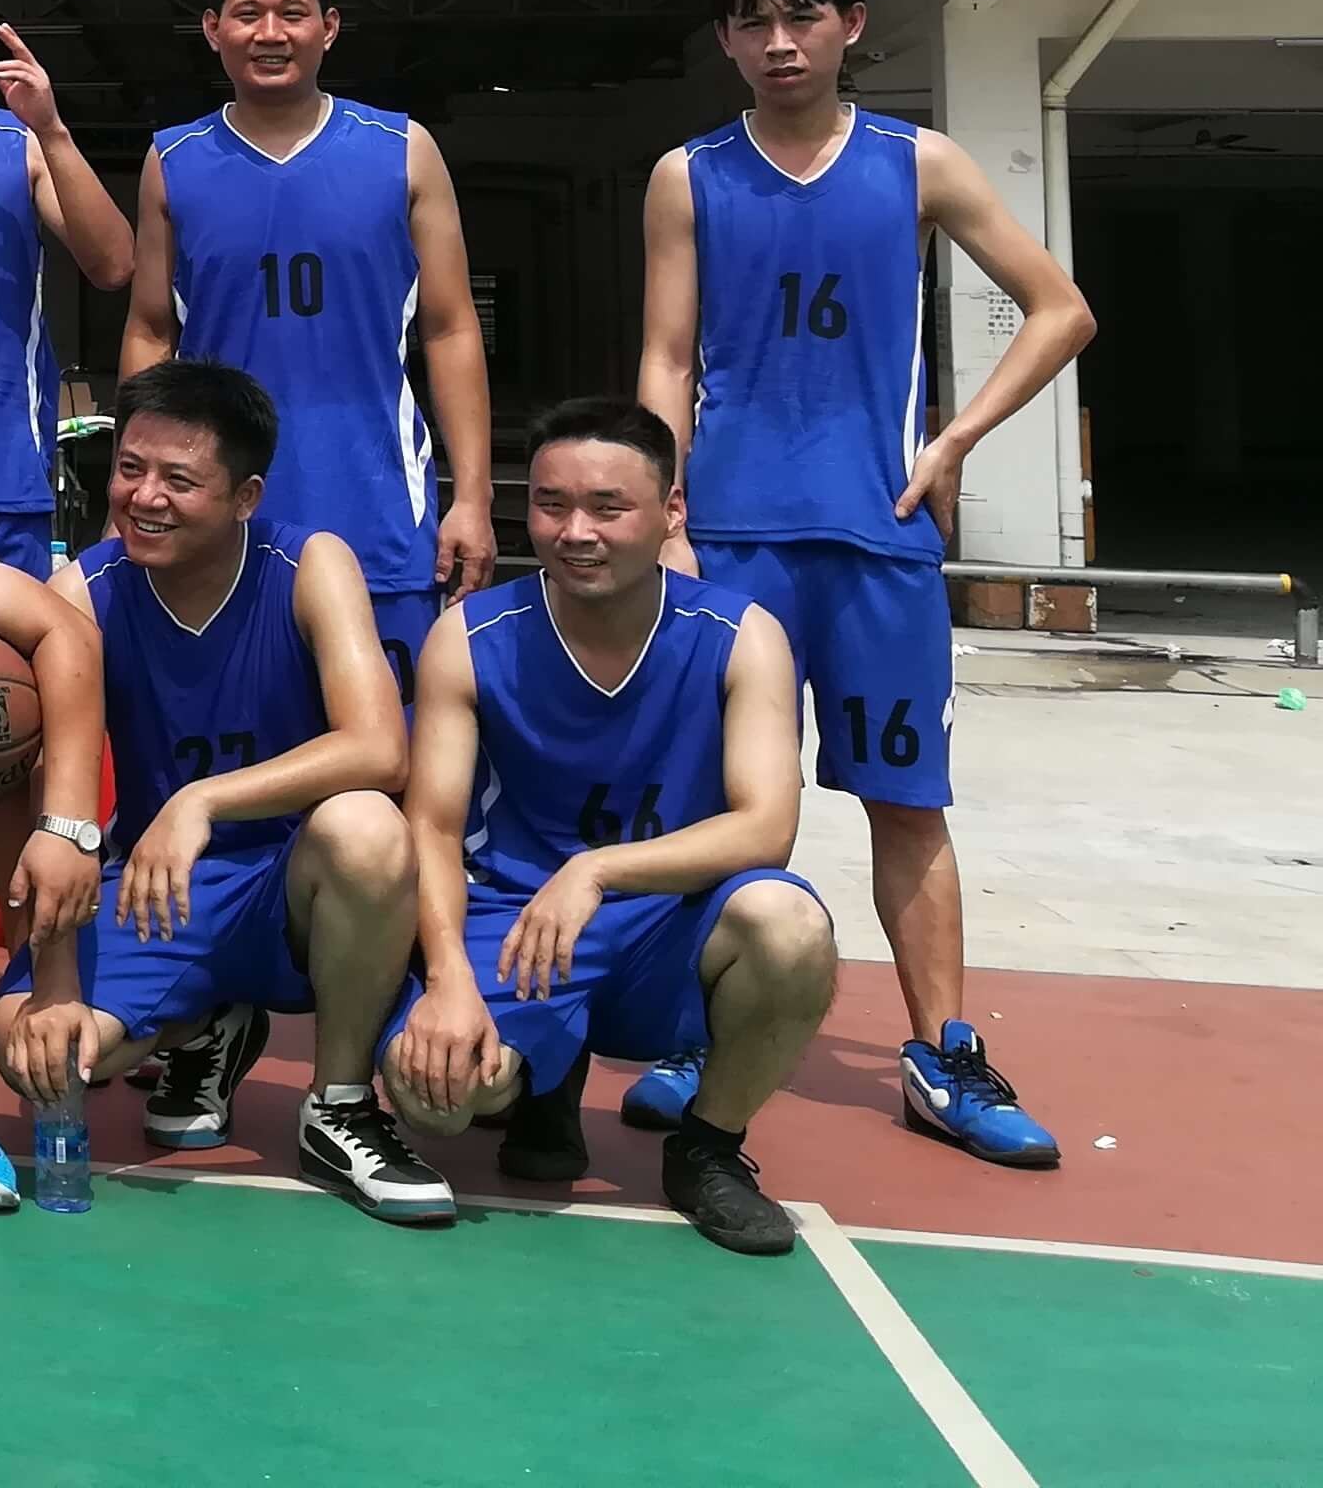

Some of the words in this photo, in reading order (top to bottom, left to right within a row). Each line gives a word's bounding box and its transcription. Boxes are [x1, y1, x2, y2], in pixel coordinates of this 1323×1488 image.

[258, 252, 324, 318] 10
[779, 271, 849, 340] 16
[174, 731, 256, 782] 27
[841, 696, 921, 768] 16
[578, 782, 664, 848] 66
